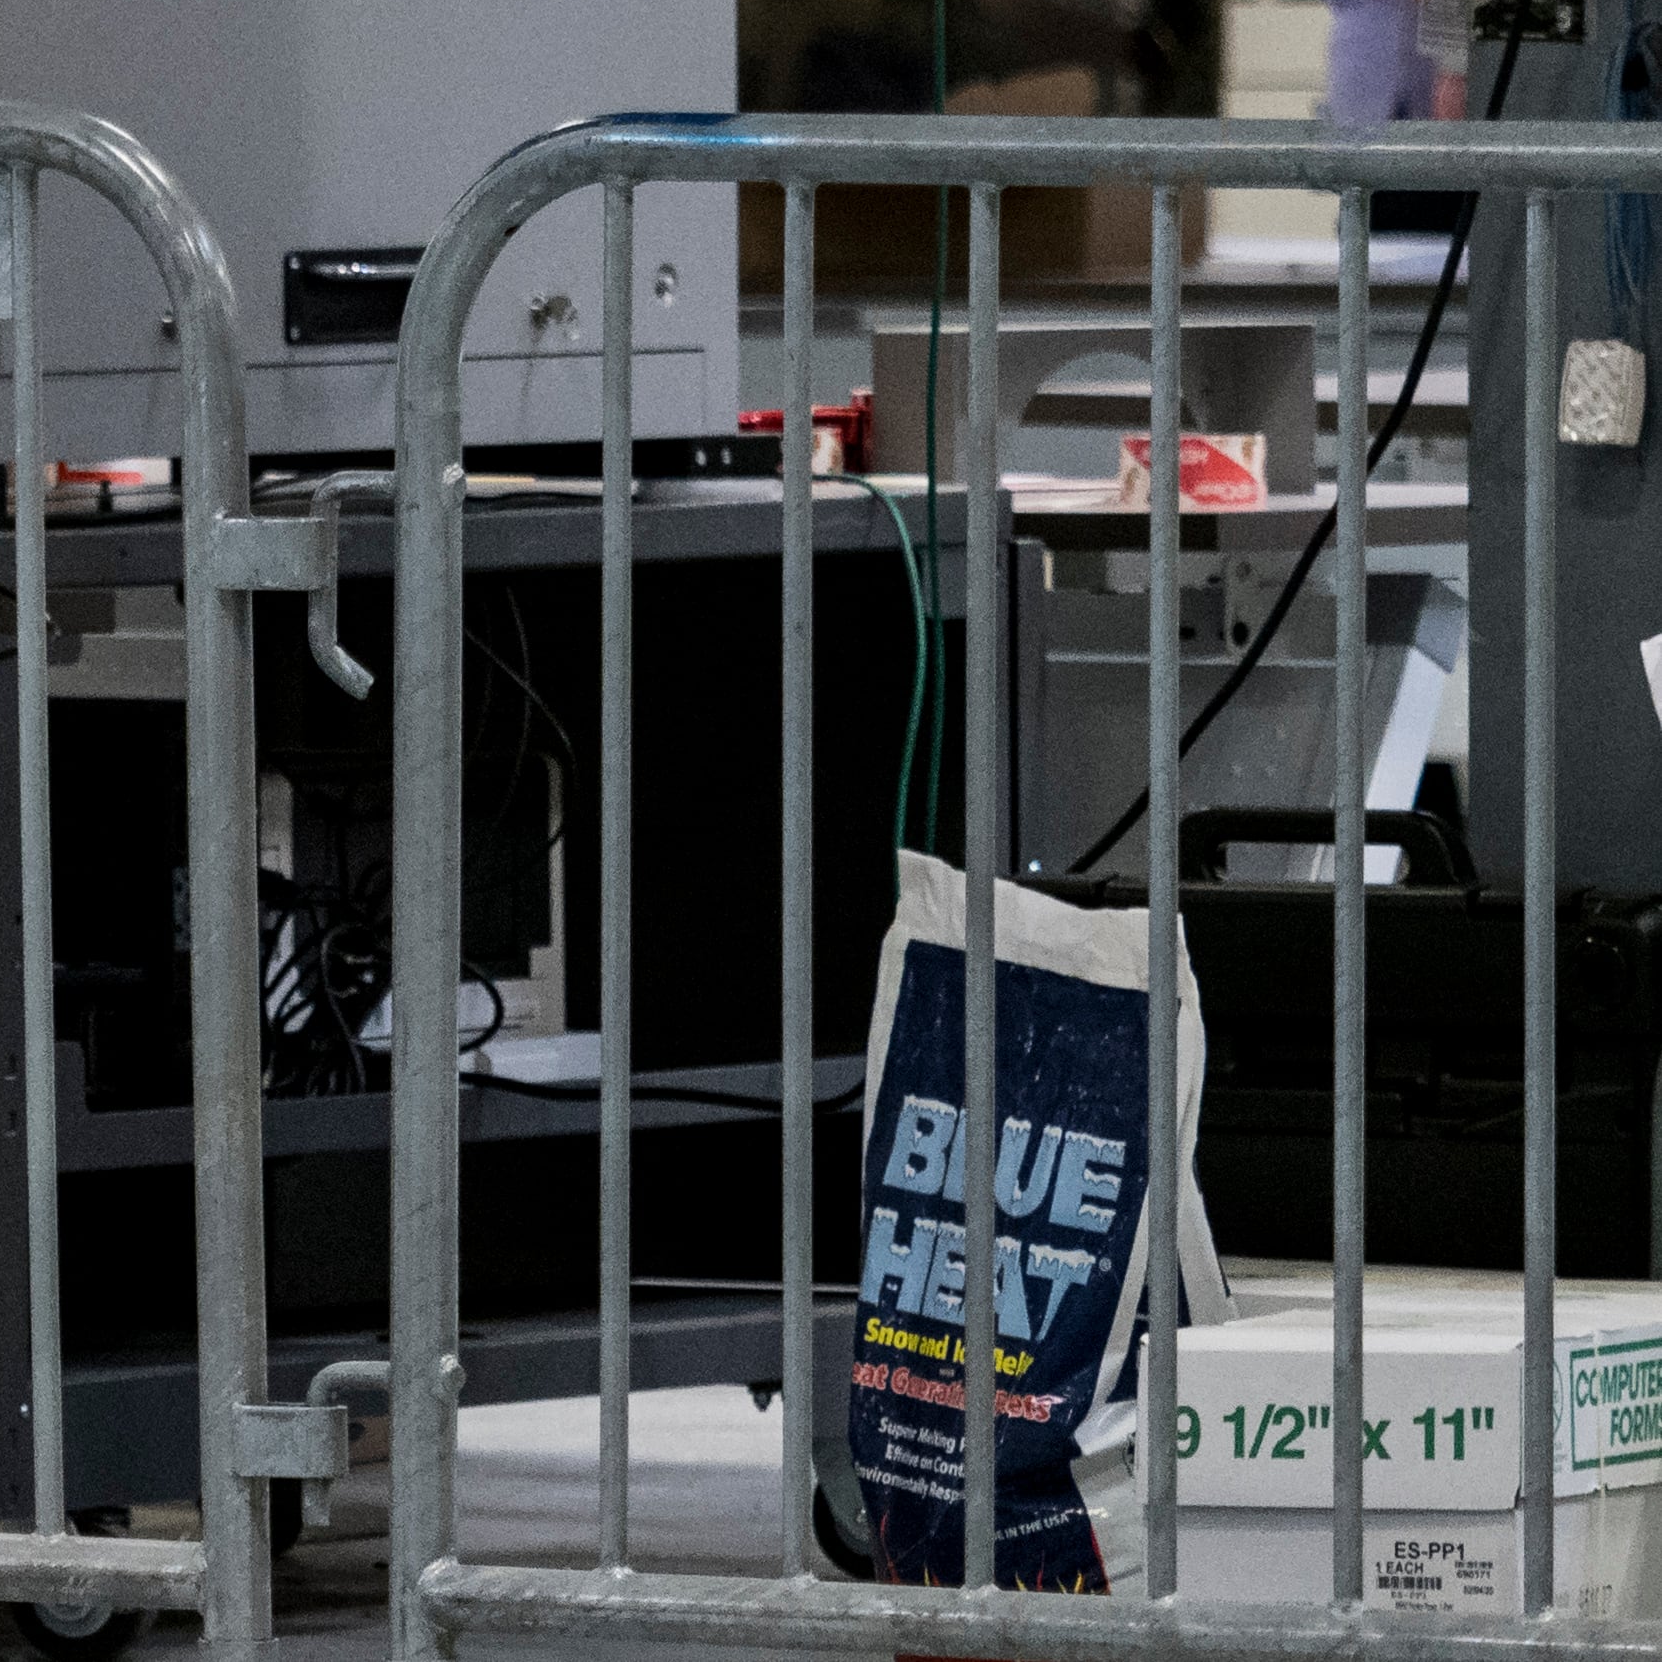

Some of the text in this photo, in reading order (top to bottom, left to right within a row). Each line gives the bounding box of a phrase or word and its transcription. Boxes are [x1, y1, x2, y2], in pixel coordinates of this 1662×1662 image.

[858, 1206, 1096, 1344] HEAT
[864, 1317, 918, 1353] Snow
[918, 1333, 950, 1361] and
[852, 1361, 889, 1391] eat
[1176, 1405, 1201, 1459] 9
[1223, 1404, 1330, 1460] 1/2"
[1362, 1419, 1391, 1460] x
[1413, 1406, 1494, 1461] 11"
[1004, 1526, 1019, 1540] IN
[1018, 1518, 1044, 1536] THE
[1043, 1512, 1070, 1530] USA
[1394, 1541, 1465, 1560] ES-PP1
[1375, 1561, 1424, 1575] 1 EACH
